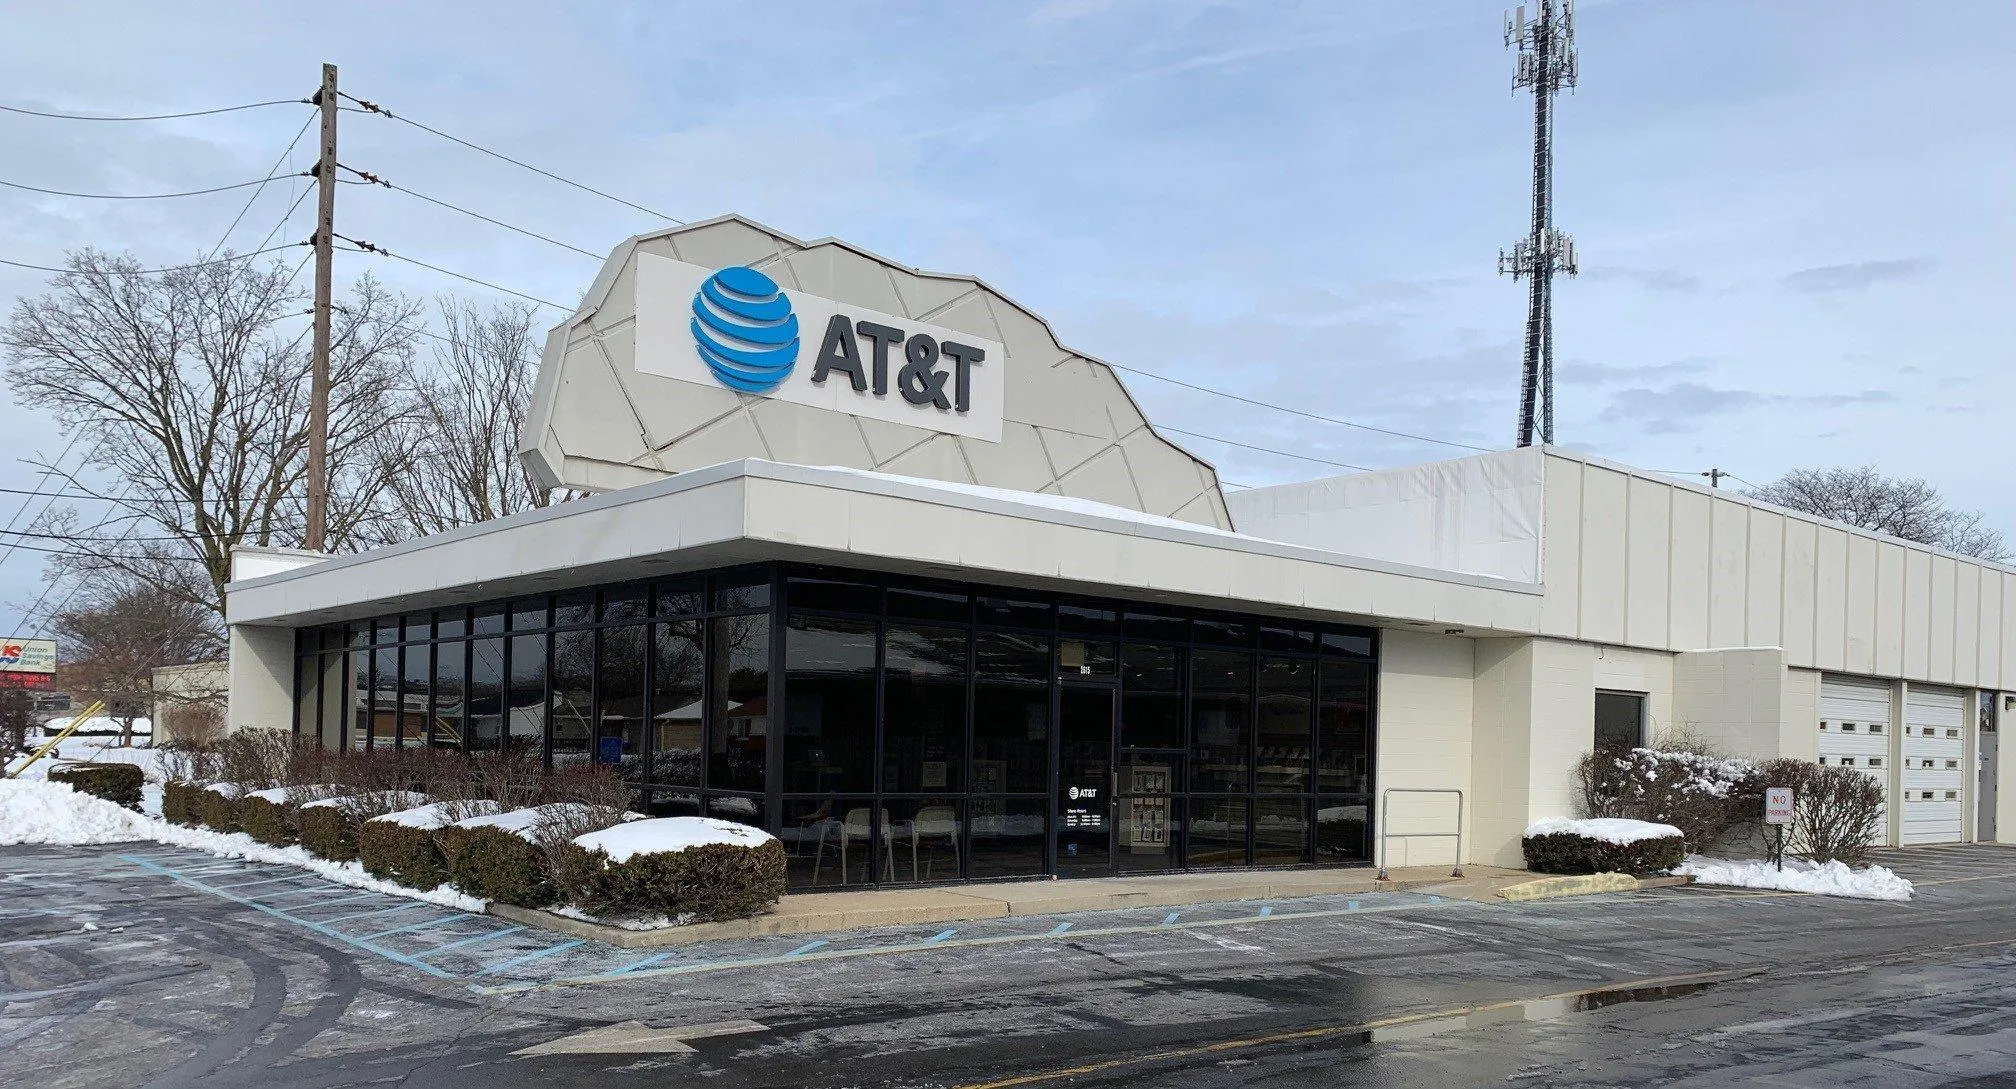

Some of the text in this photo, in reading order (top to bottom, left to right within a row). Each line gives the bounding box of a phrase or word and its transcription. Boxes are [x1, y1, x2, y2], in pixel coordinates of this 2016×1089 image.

[811, 314, 985, 412] AT&T
[22, 653, 54, 661] Savings
[1079, 789, 1097, 798] AT&T
[1772, 795, 1786, 804] NO
